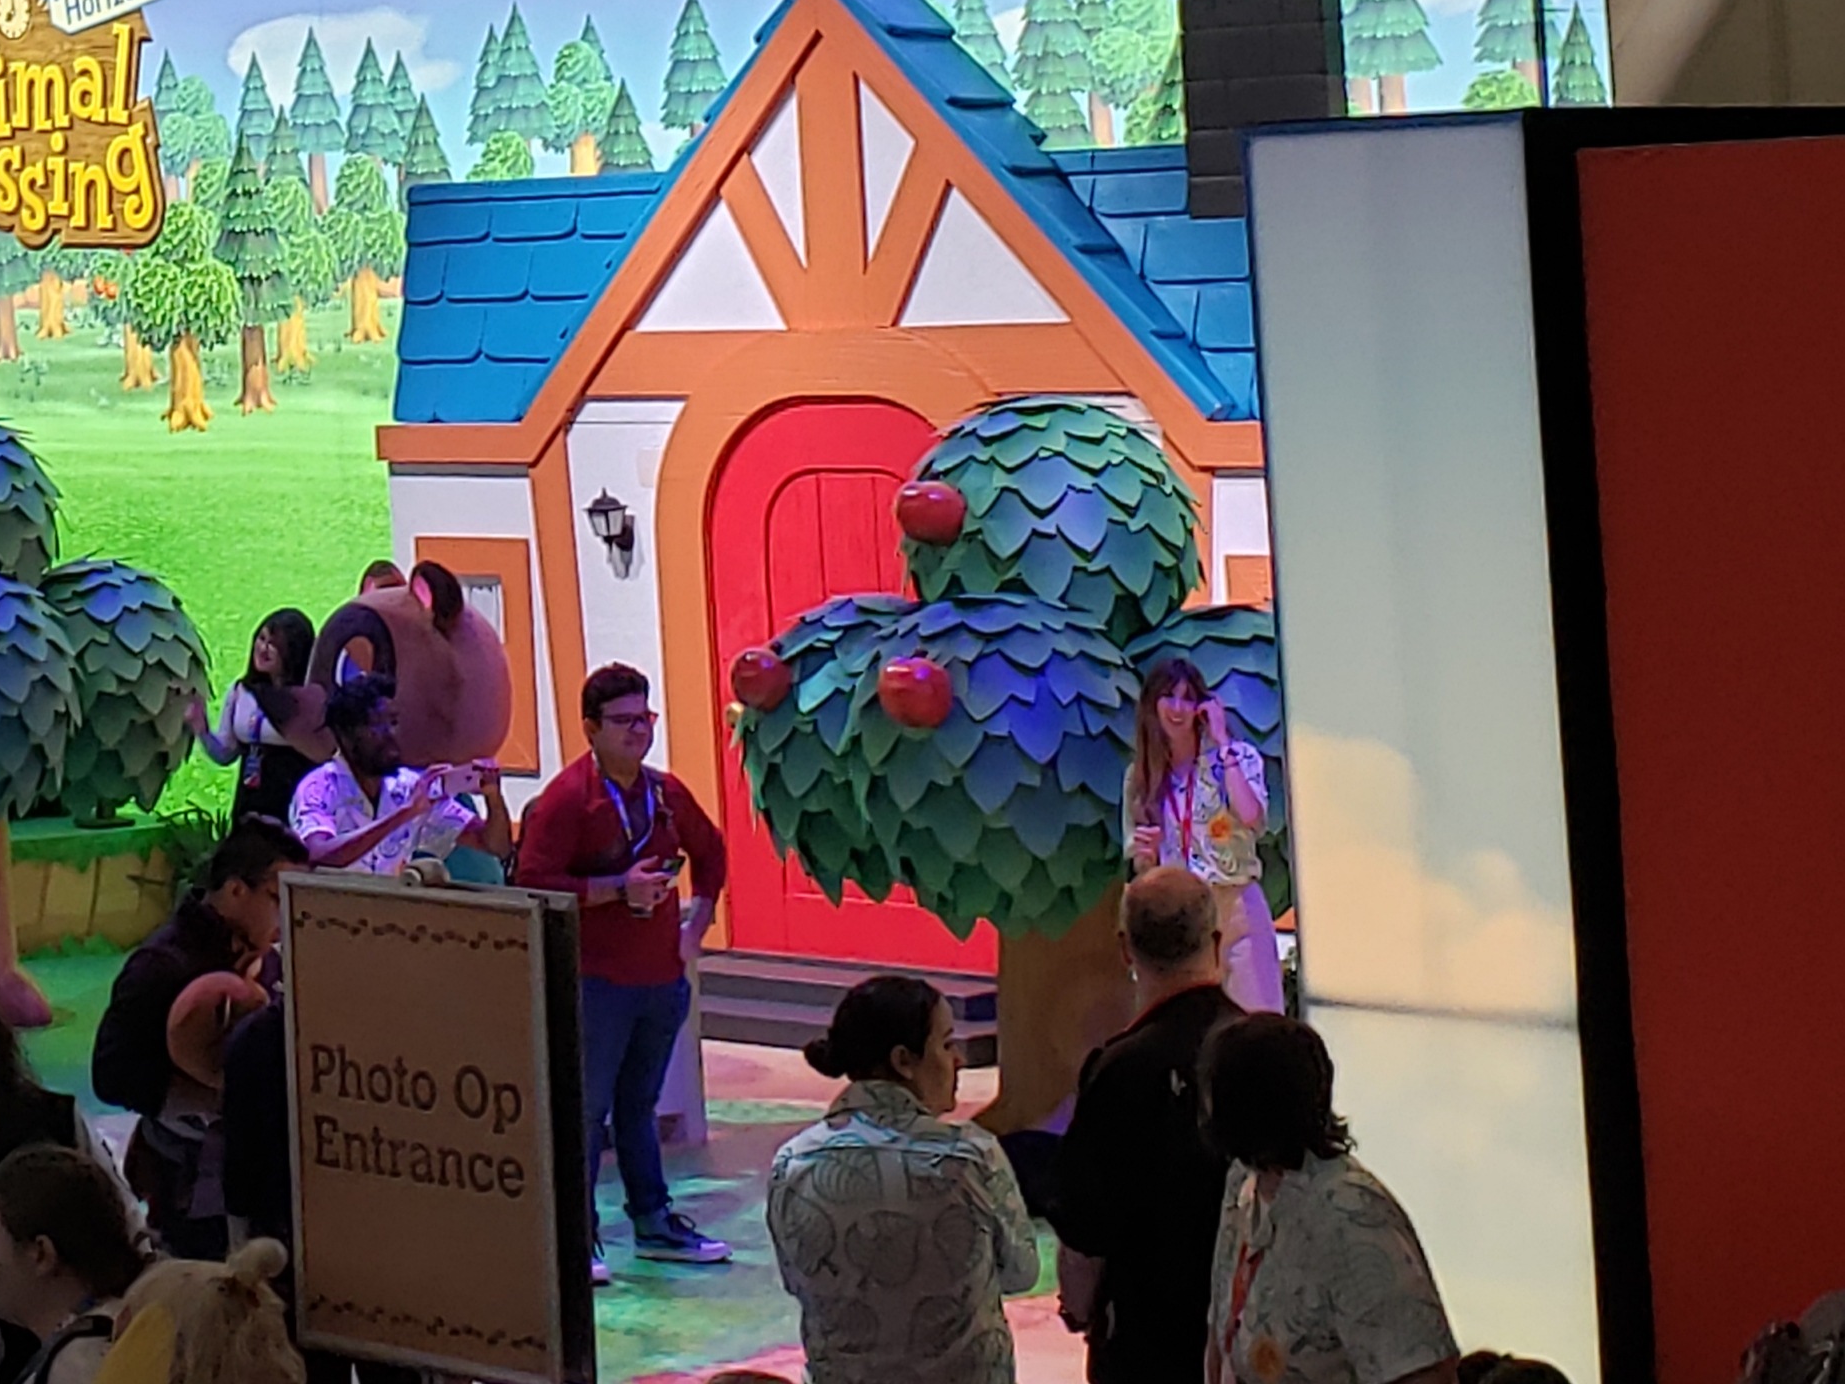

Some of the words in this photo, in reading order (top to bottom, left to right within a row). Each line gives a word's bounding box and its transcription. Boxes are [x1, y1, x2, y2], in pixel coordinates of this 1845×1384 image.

[310, 1043, 437, 1111] Photo
[454, 1064, 522, 1135] Op
[313, 1114, 525, 1199] Entrance
